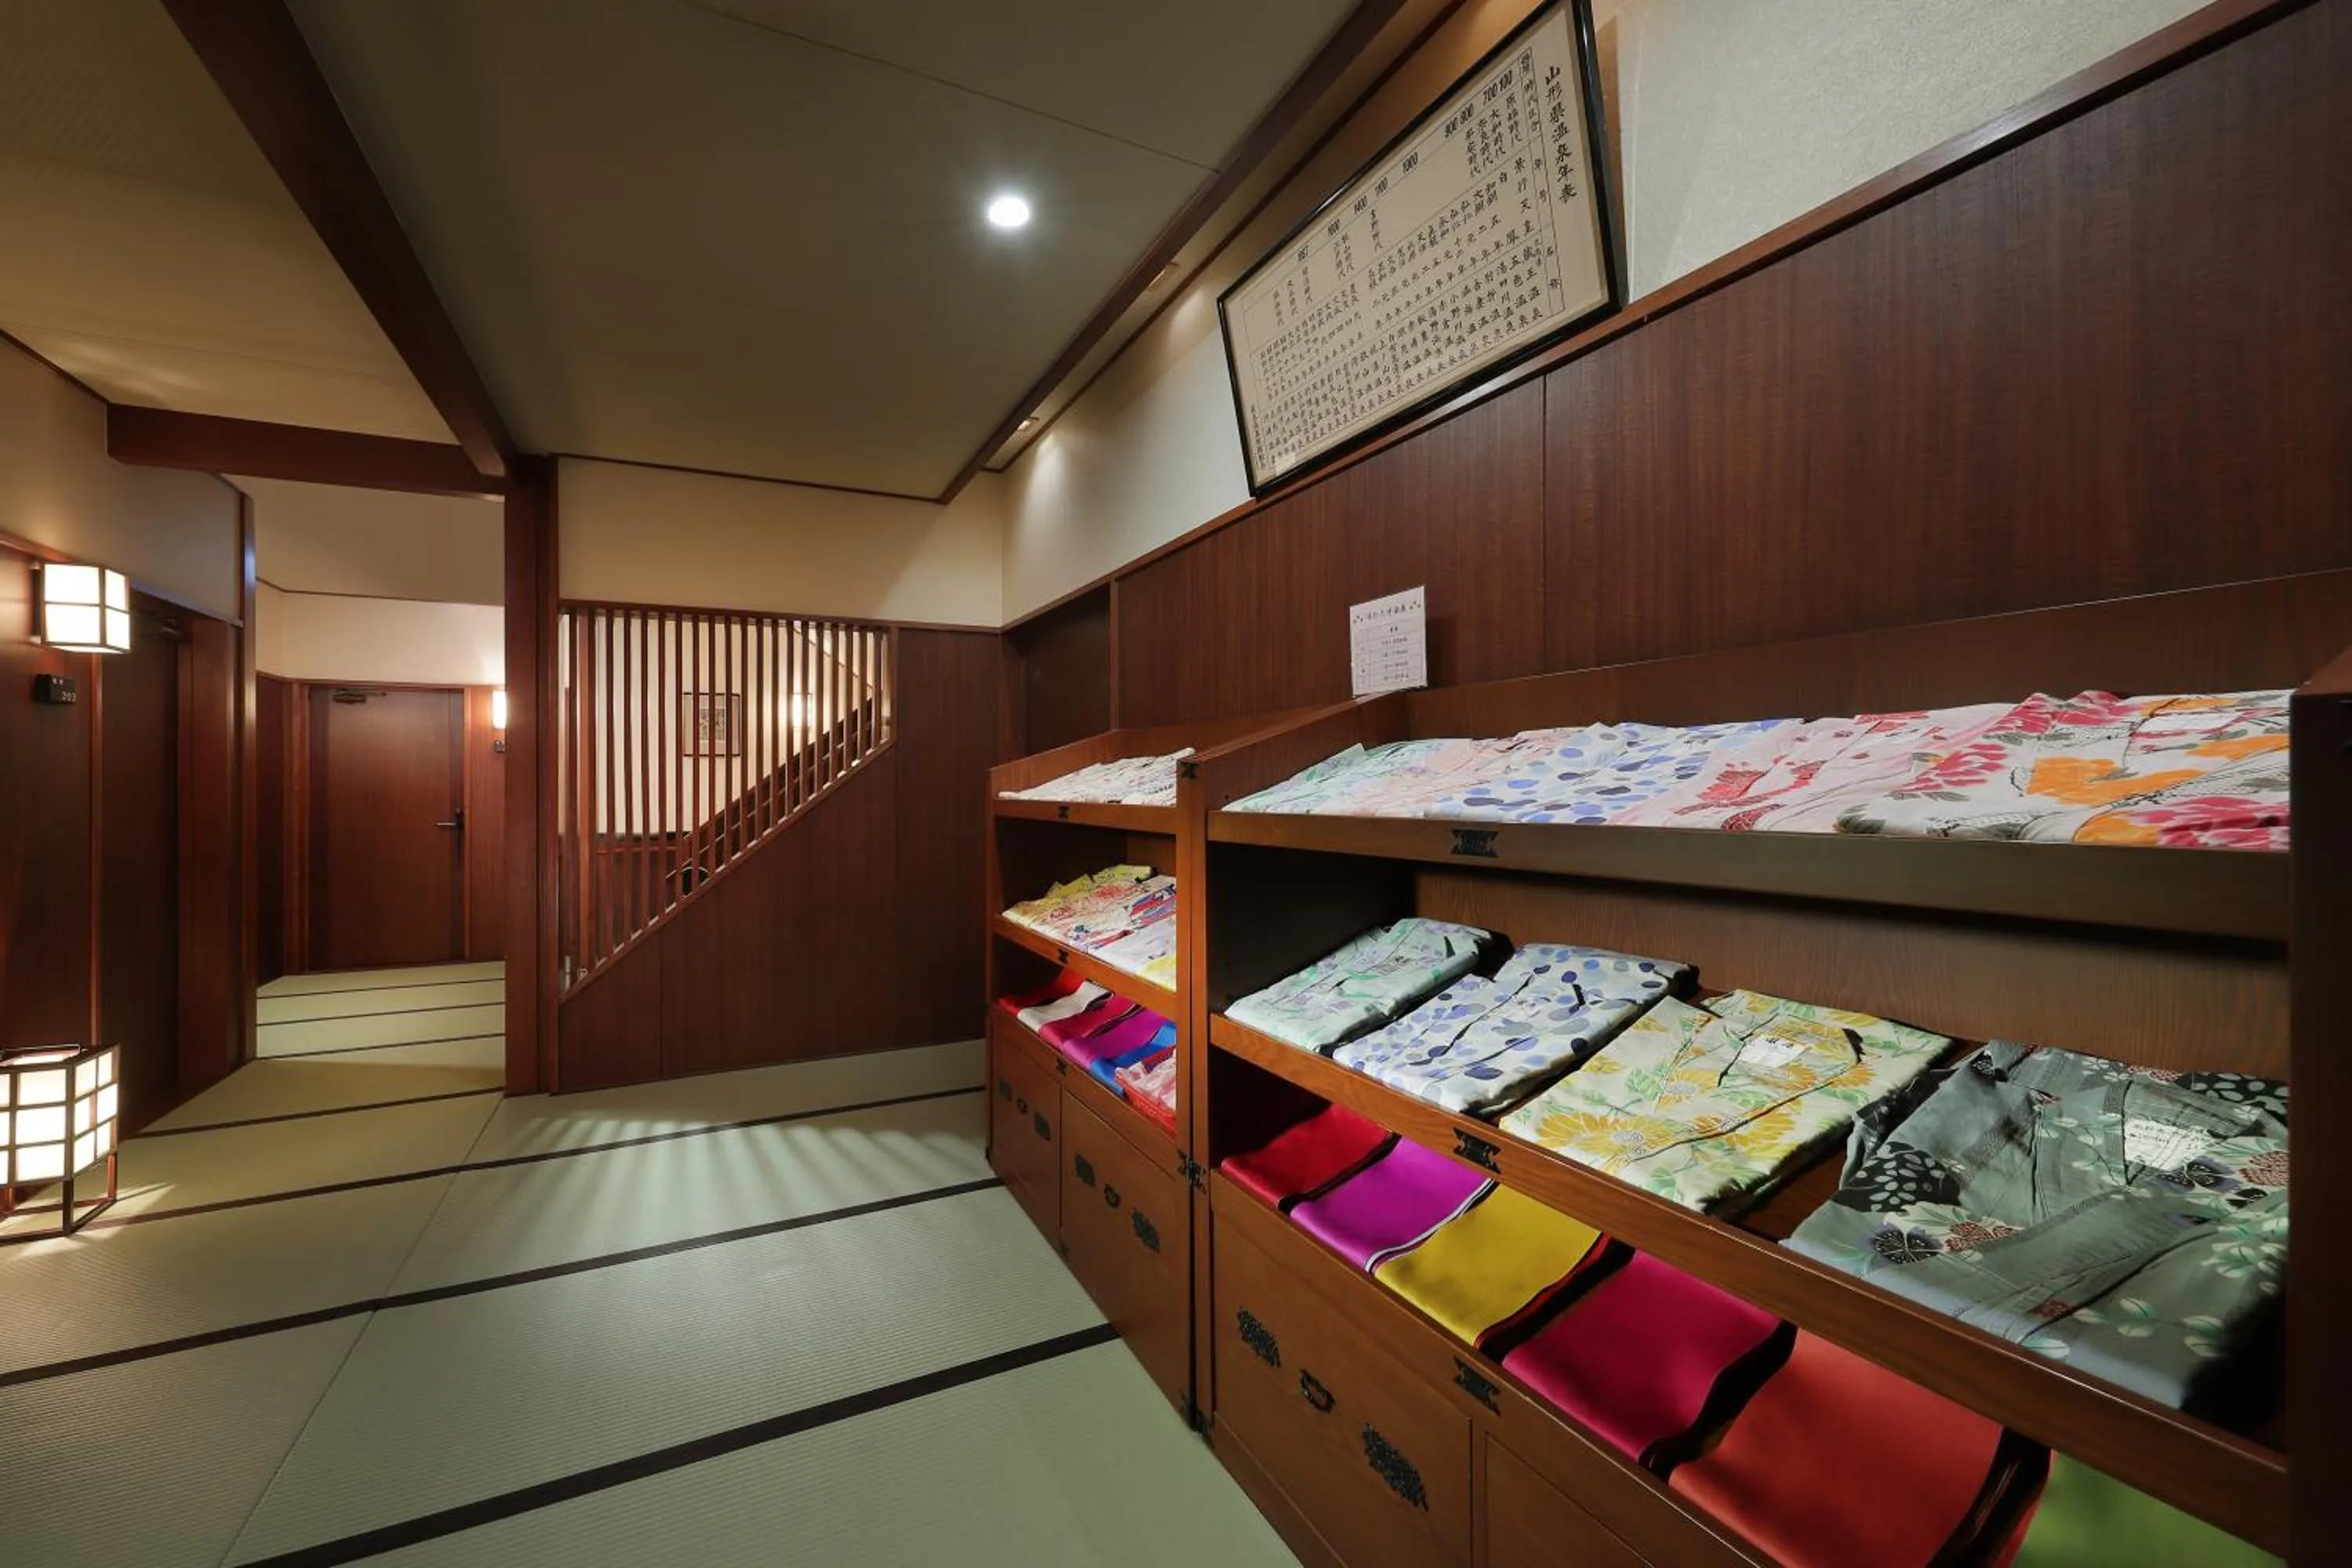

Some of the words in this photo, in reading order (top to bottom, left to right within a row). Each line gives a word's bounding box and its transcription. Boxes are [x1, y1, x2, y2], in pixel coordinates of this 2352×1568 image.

[1545, 66, 1577, 205] 山形県温泉年表
